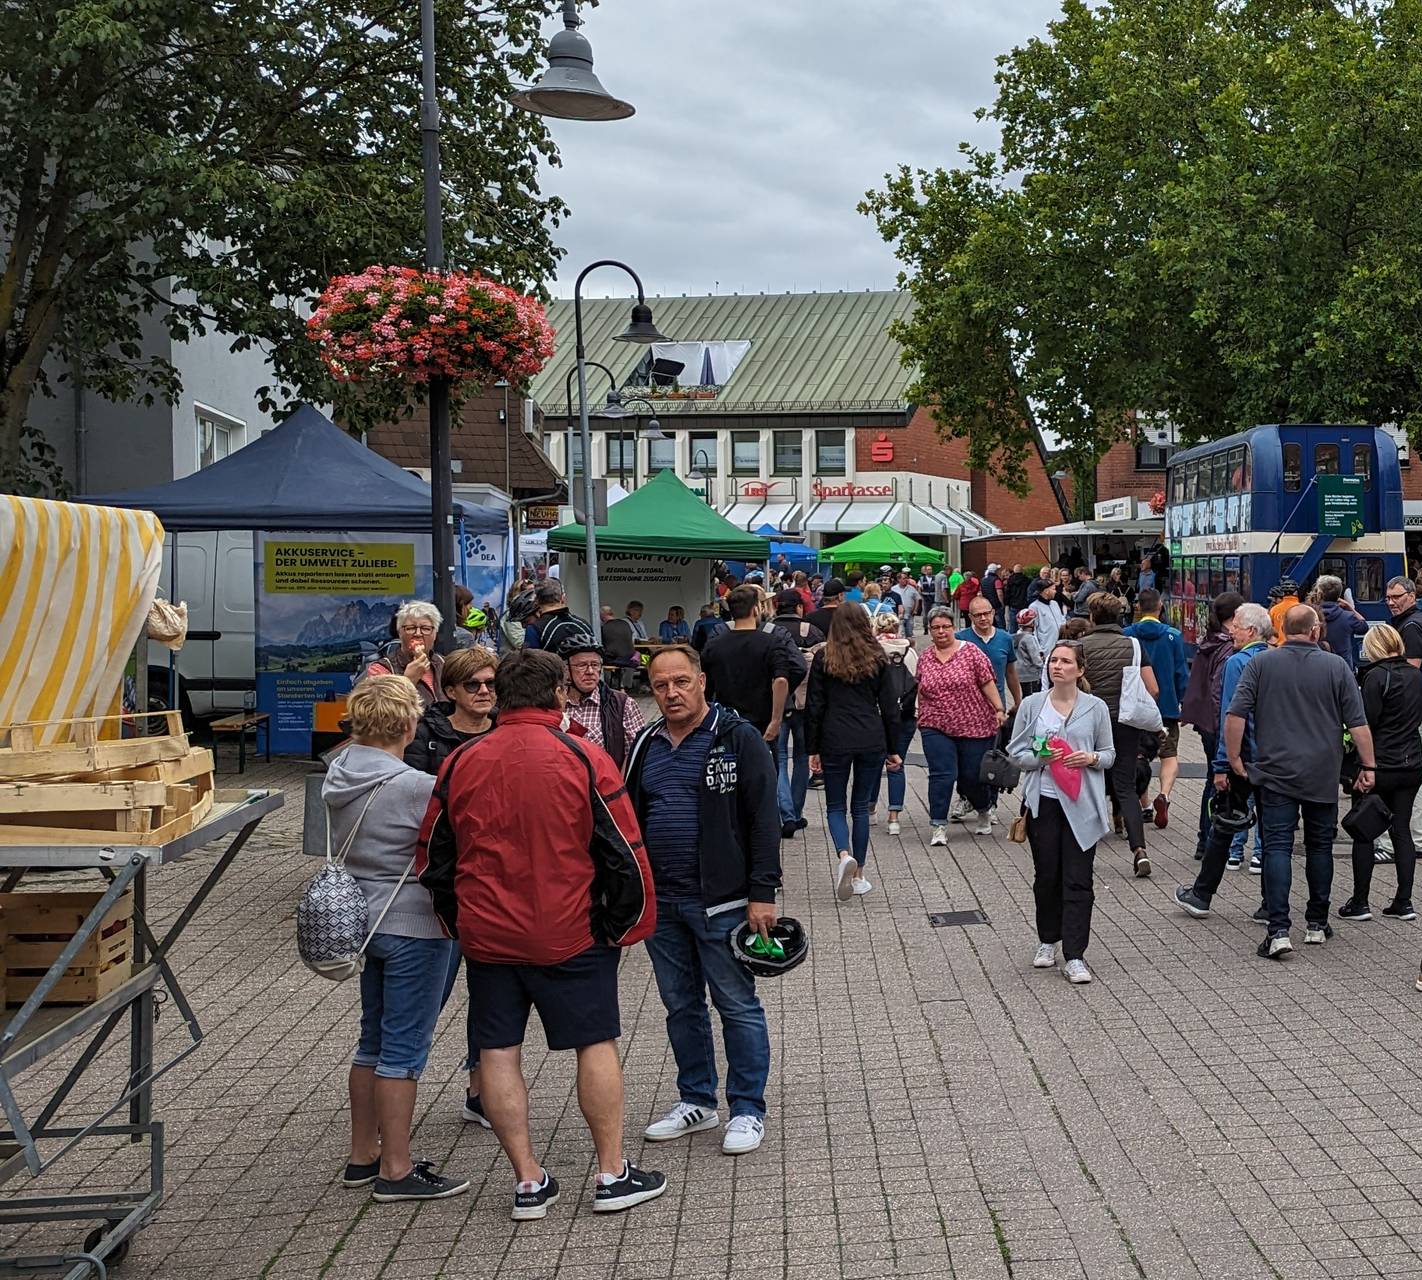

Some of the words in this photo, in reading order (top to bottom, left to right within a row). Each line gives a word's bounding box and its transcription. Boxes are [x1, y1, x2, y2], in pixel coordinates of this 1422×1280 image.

[813, 482, 893, 500] Sparkasse
[275, 548, 355, 557] AKKUSERVICE
[481, 553, 496, 561] DEA
[275, 558, 297, 567] DER
[300, 558, 348, 568] UMWELT
[350, 559, 398, 568] ZULIEBE:
[706, 762, 737, 775] CAMP
[706, 773, 737, 787] DAVID
